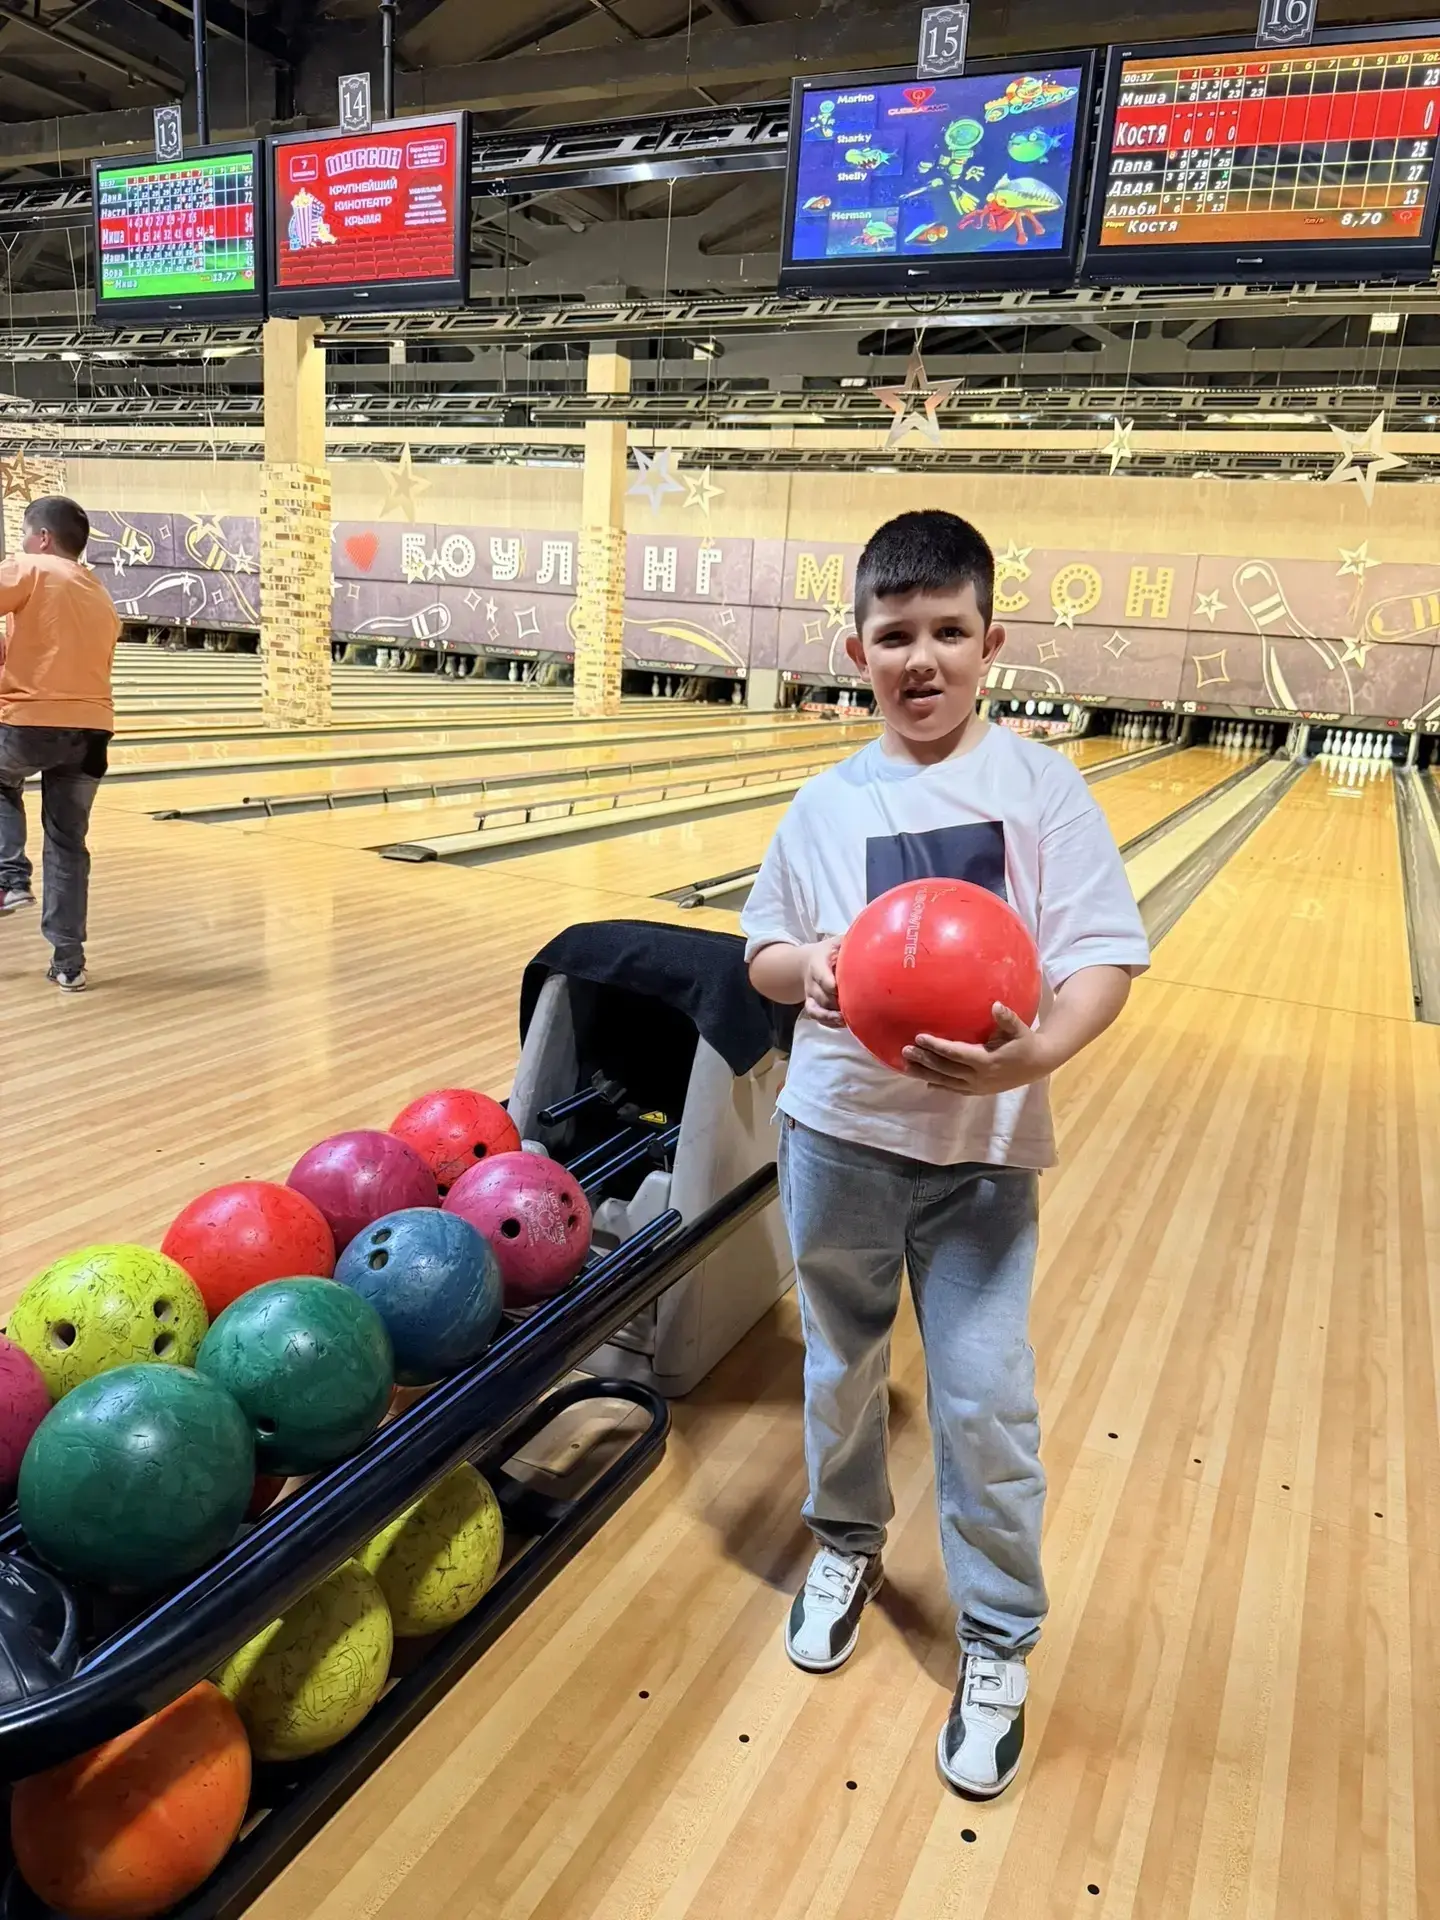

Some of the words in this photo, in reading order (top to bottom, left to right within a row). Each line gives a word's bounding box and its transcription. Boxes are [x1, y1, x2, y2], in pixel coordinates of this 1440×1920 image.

[1267, 0, 1307, 25] 16
[926, 25, 959, 59] 15
[1124, 73, 1154, 83] 00:37
[1395, 55, 1409, 64] 10
[1120, 93, 1166, 106] Миша
[1423, 69, 1440, 86] 23
[343, 90, 366, 119] 14
[837, 93, 875, 104] Marino
[1115, 122, 1168, 147] Костя
[1424, 100, 1434, 130] 0
[159, 121, 177, 147] 13
[837, 133, 872, 144] Sharky
[325, 147, 403, 177] МУССОН
[1112, 159, 1153, 173] Папа
[1411, 140, 1428, 158] 25
[300, 160, 307, 170] 7
[837, 172, 867, 182] Shelly
[1108, 181, 1153, 196] Дядя
[1407, 164, 1424, 181] 27
[329, 177, 398, 196] КРУПНЕЙШИЙ
[101, 193, 121, 204] Даня
[101, 205, 127, 218] Настя
[244, 191, 253, 203] 72
[334, 196, 393, 211] КИНОТЕАТР
[1107, 202, 1157, 216] Альби
[1403, 188, 1419, 205] 13
[344, 213, 382, 227] КРЫМА
[831, 211, 872, 220] Herman
[1341, 212, 1382, 227] 8,70
[1128, 219, 1178, 233] Костя
[212, 271, 237, 283] 13,77
[428, 641, 435, 649] 6
[442, 640, 449, 650] 7
[736, 667, 746, 677] 10
[782, 671, 791, 681] 11
[1161, 700, 1176, 710] 14
[1183, 701, 1197, 713] 15
[1402, 718, 1416, 730] 16
[1425, 720, 1440, 732] 17
